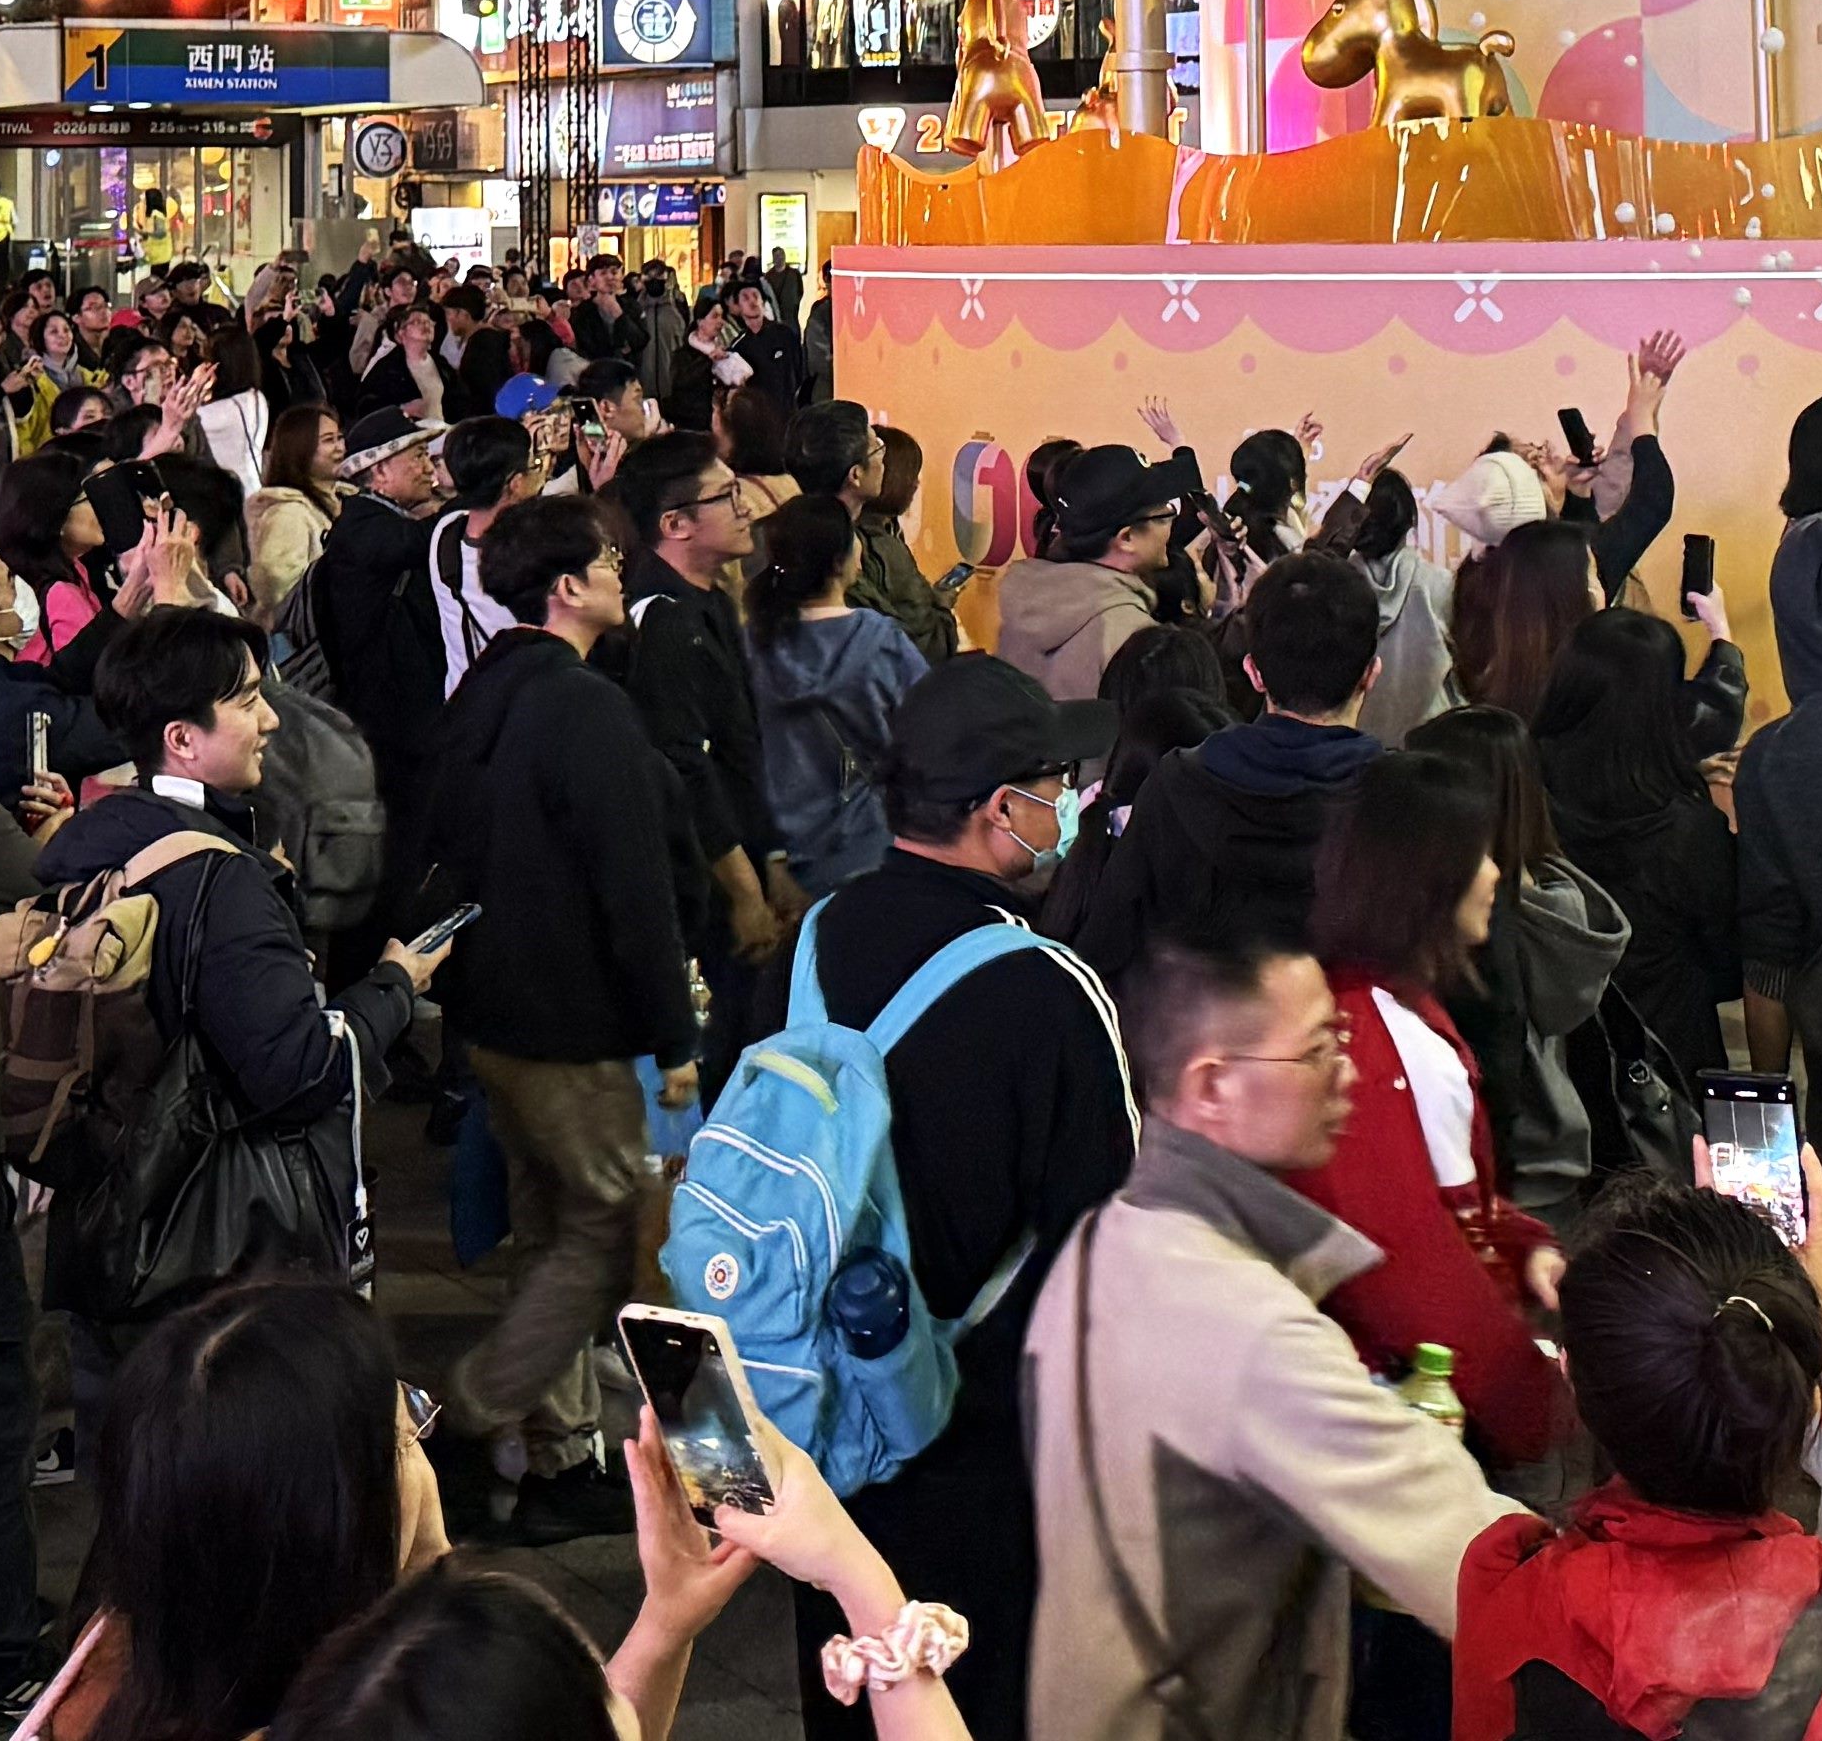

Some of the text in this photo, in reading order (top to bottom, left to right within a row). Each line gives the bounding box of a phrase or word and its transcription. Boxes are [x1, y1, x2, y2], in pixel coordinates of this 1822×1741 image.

[85, 43, 109, 91] 1
[186, 43, 276, 75] 西門站
[184, 76, 279, 90] XIMEN STATION
